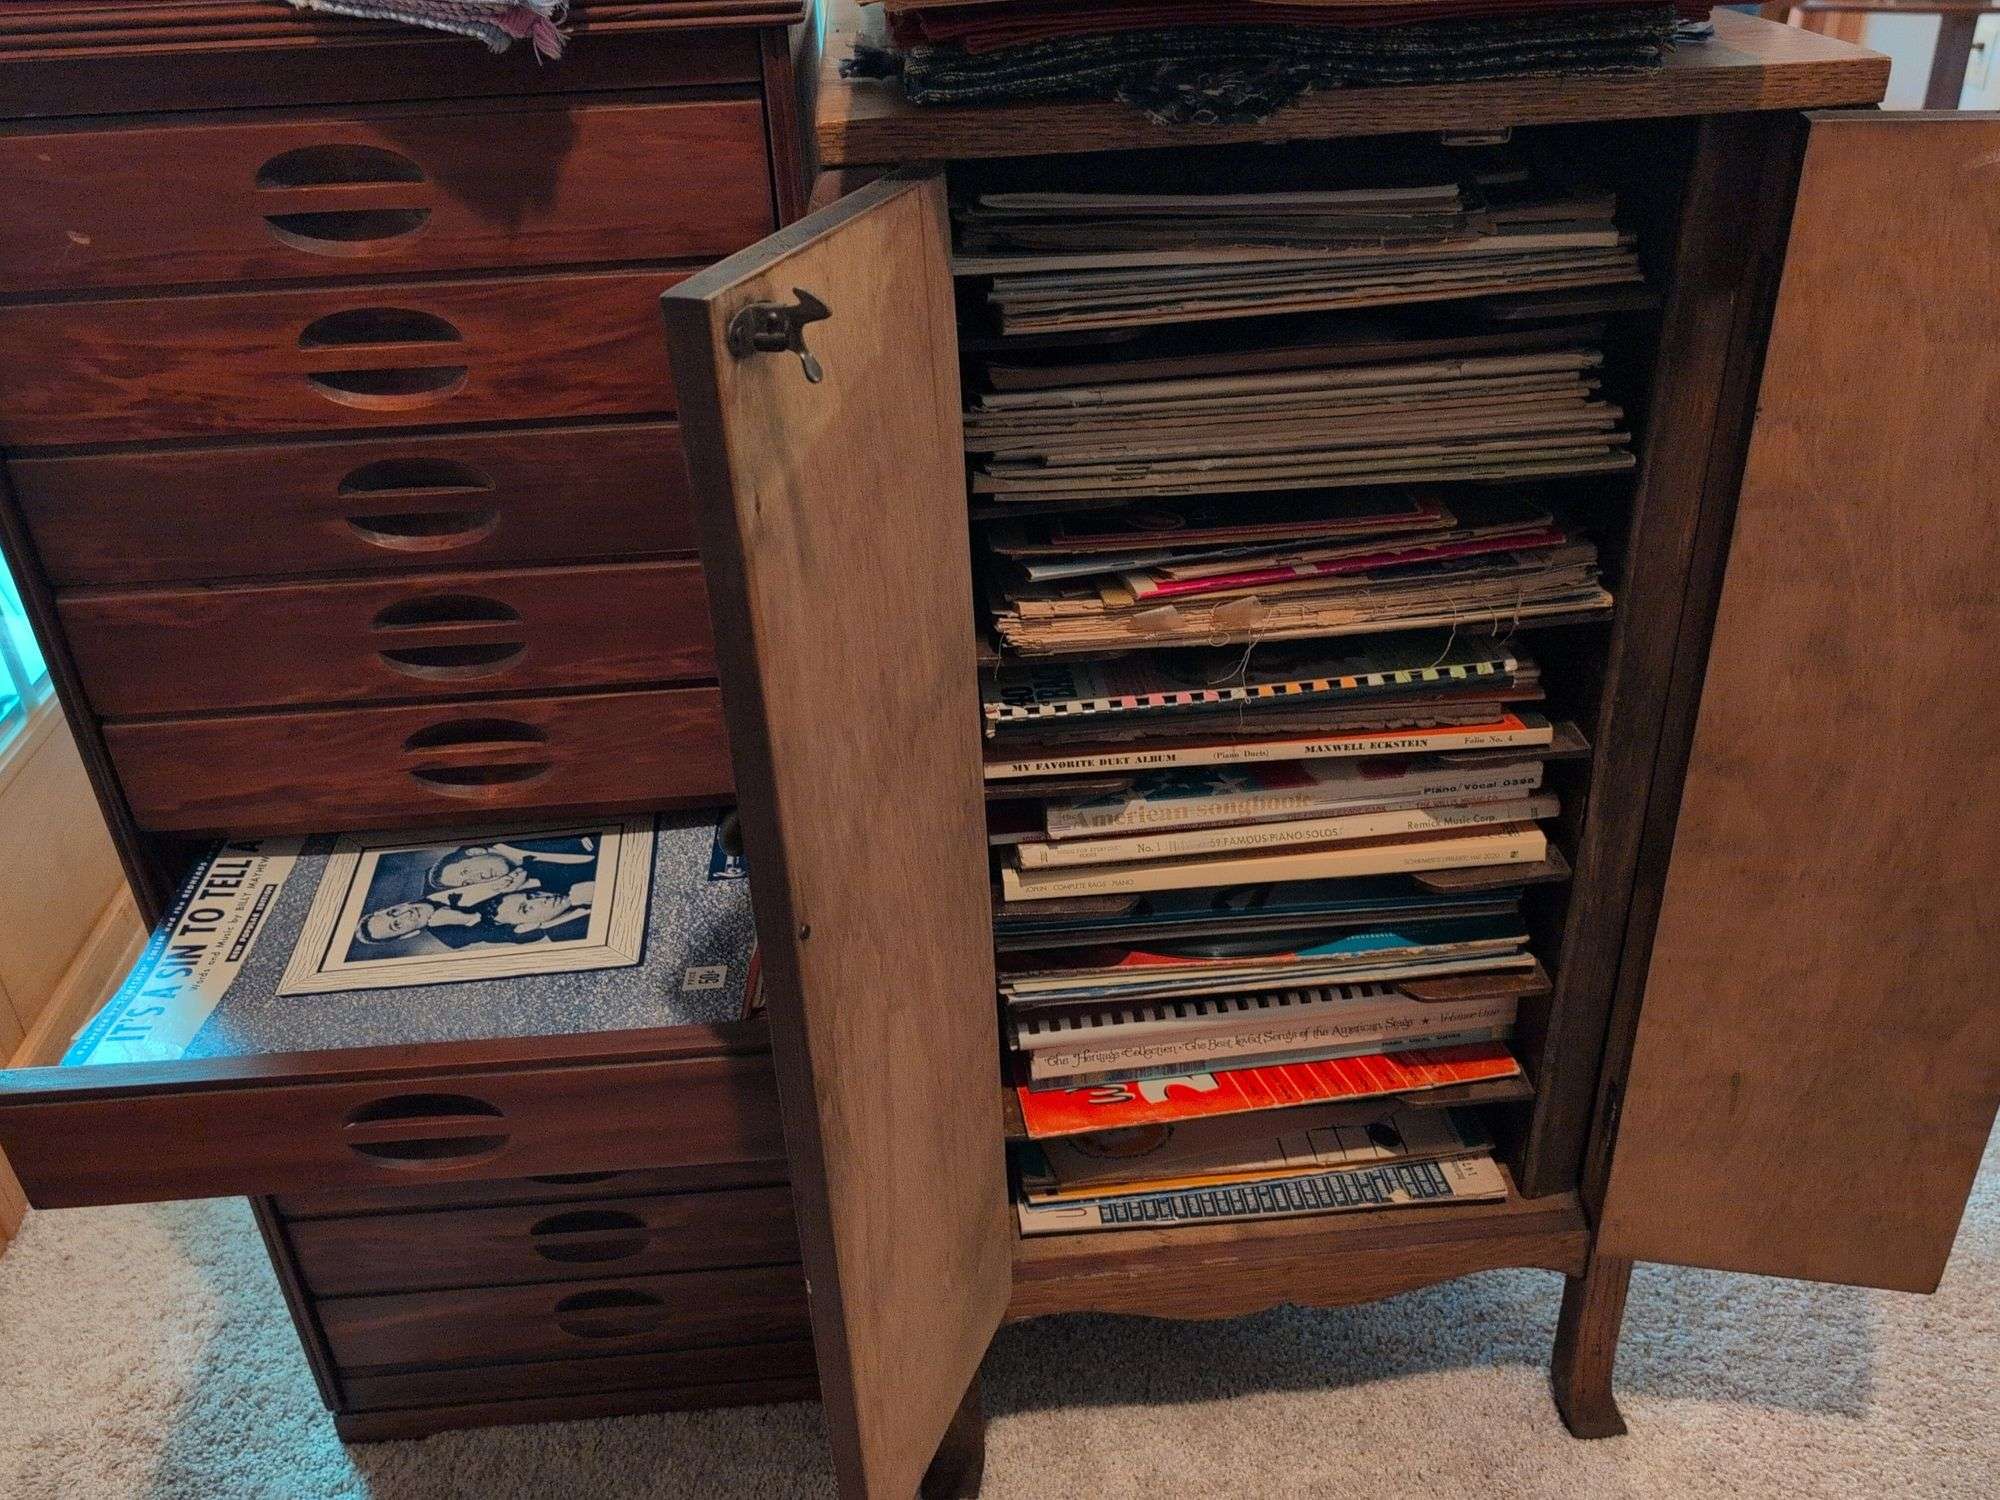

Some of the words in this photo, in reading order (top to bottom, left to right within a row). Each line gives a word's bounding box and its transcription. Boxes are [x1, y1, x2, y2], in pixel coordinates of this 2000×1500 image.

[1012, 763, 1032, 772] MY
[1036, 758, 1095, 771] FAVORITE
[1099, 757, 1130, 767] DUET
[1135, 754, 1176, 764] ALBUM
[1213, 751, 1240, 761] (Piano
[1244, 749, 1270, 759] Duets)
[1304, 741, 1366, 753] MAXWELL
[1370, 738, 1428, 751] ECKSTEIN
[1464, 736, 1485, 745] Folio
[1489, 735, 1503, 744] No.
[1507, 734, 1513, 742] 4
[1074, 805, 1190, 828] American
[1197, 793, 1312, 819] songbook
[1424, 782, 1496, 795] Piano/Vocal
[1137, 843, 1154, 853] No.
[1223, 834, 1267, 846] FAMOUS
[1269, 831, 1304, 841] PIANO
[1305, 827, 1339, 839] SOLOS
[1407, 817, 1440, 830] Remick
[1444, 814, 1471, 825] Music
[1473, 814, 1498, 824] Corp.
[199, 859, 253, 900] TELL
[178, 907, 225, 937] TO
[216, 926, 234, 948] Music
[155, 944, 209, 979] SIN
[143, 985, 184, 1000] A
[106, 1005, 166, 1042] IT'S
[1072, 1049, 1121, 1068] Heritage
[1121, 1045, 1177, 1060] Collection
[1262, 1029, 1298, 1045] Songs
[1299, 1027, 1310, 1040] of
[1332, 1020, 1383, 1040] American
